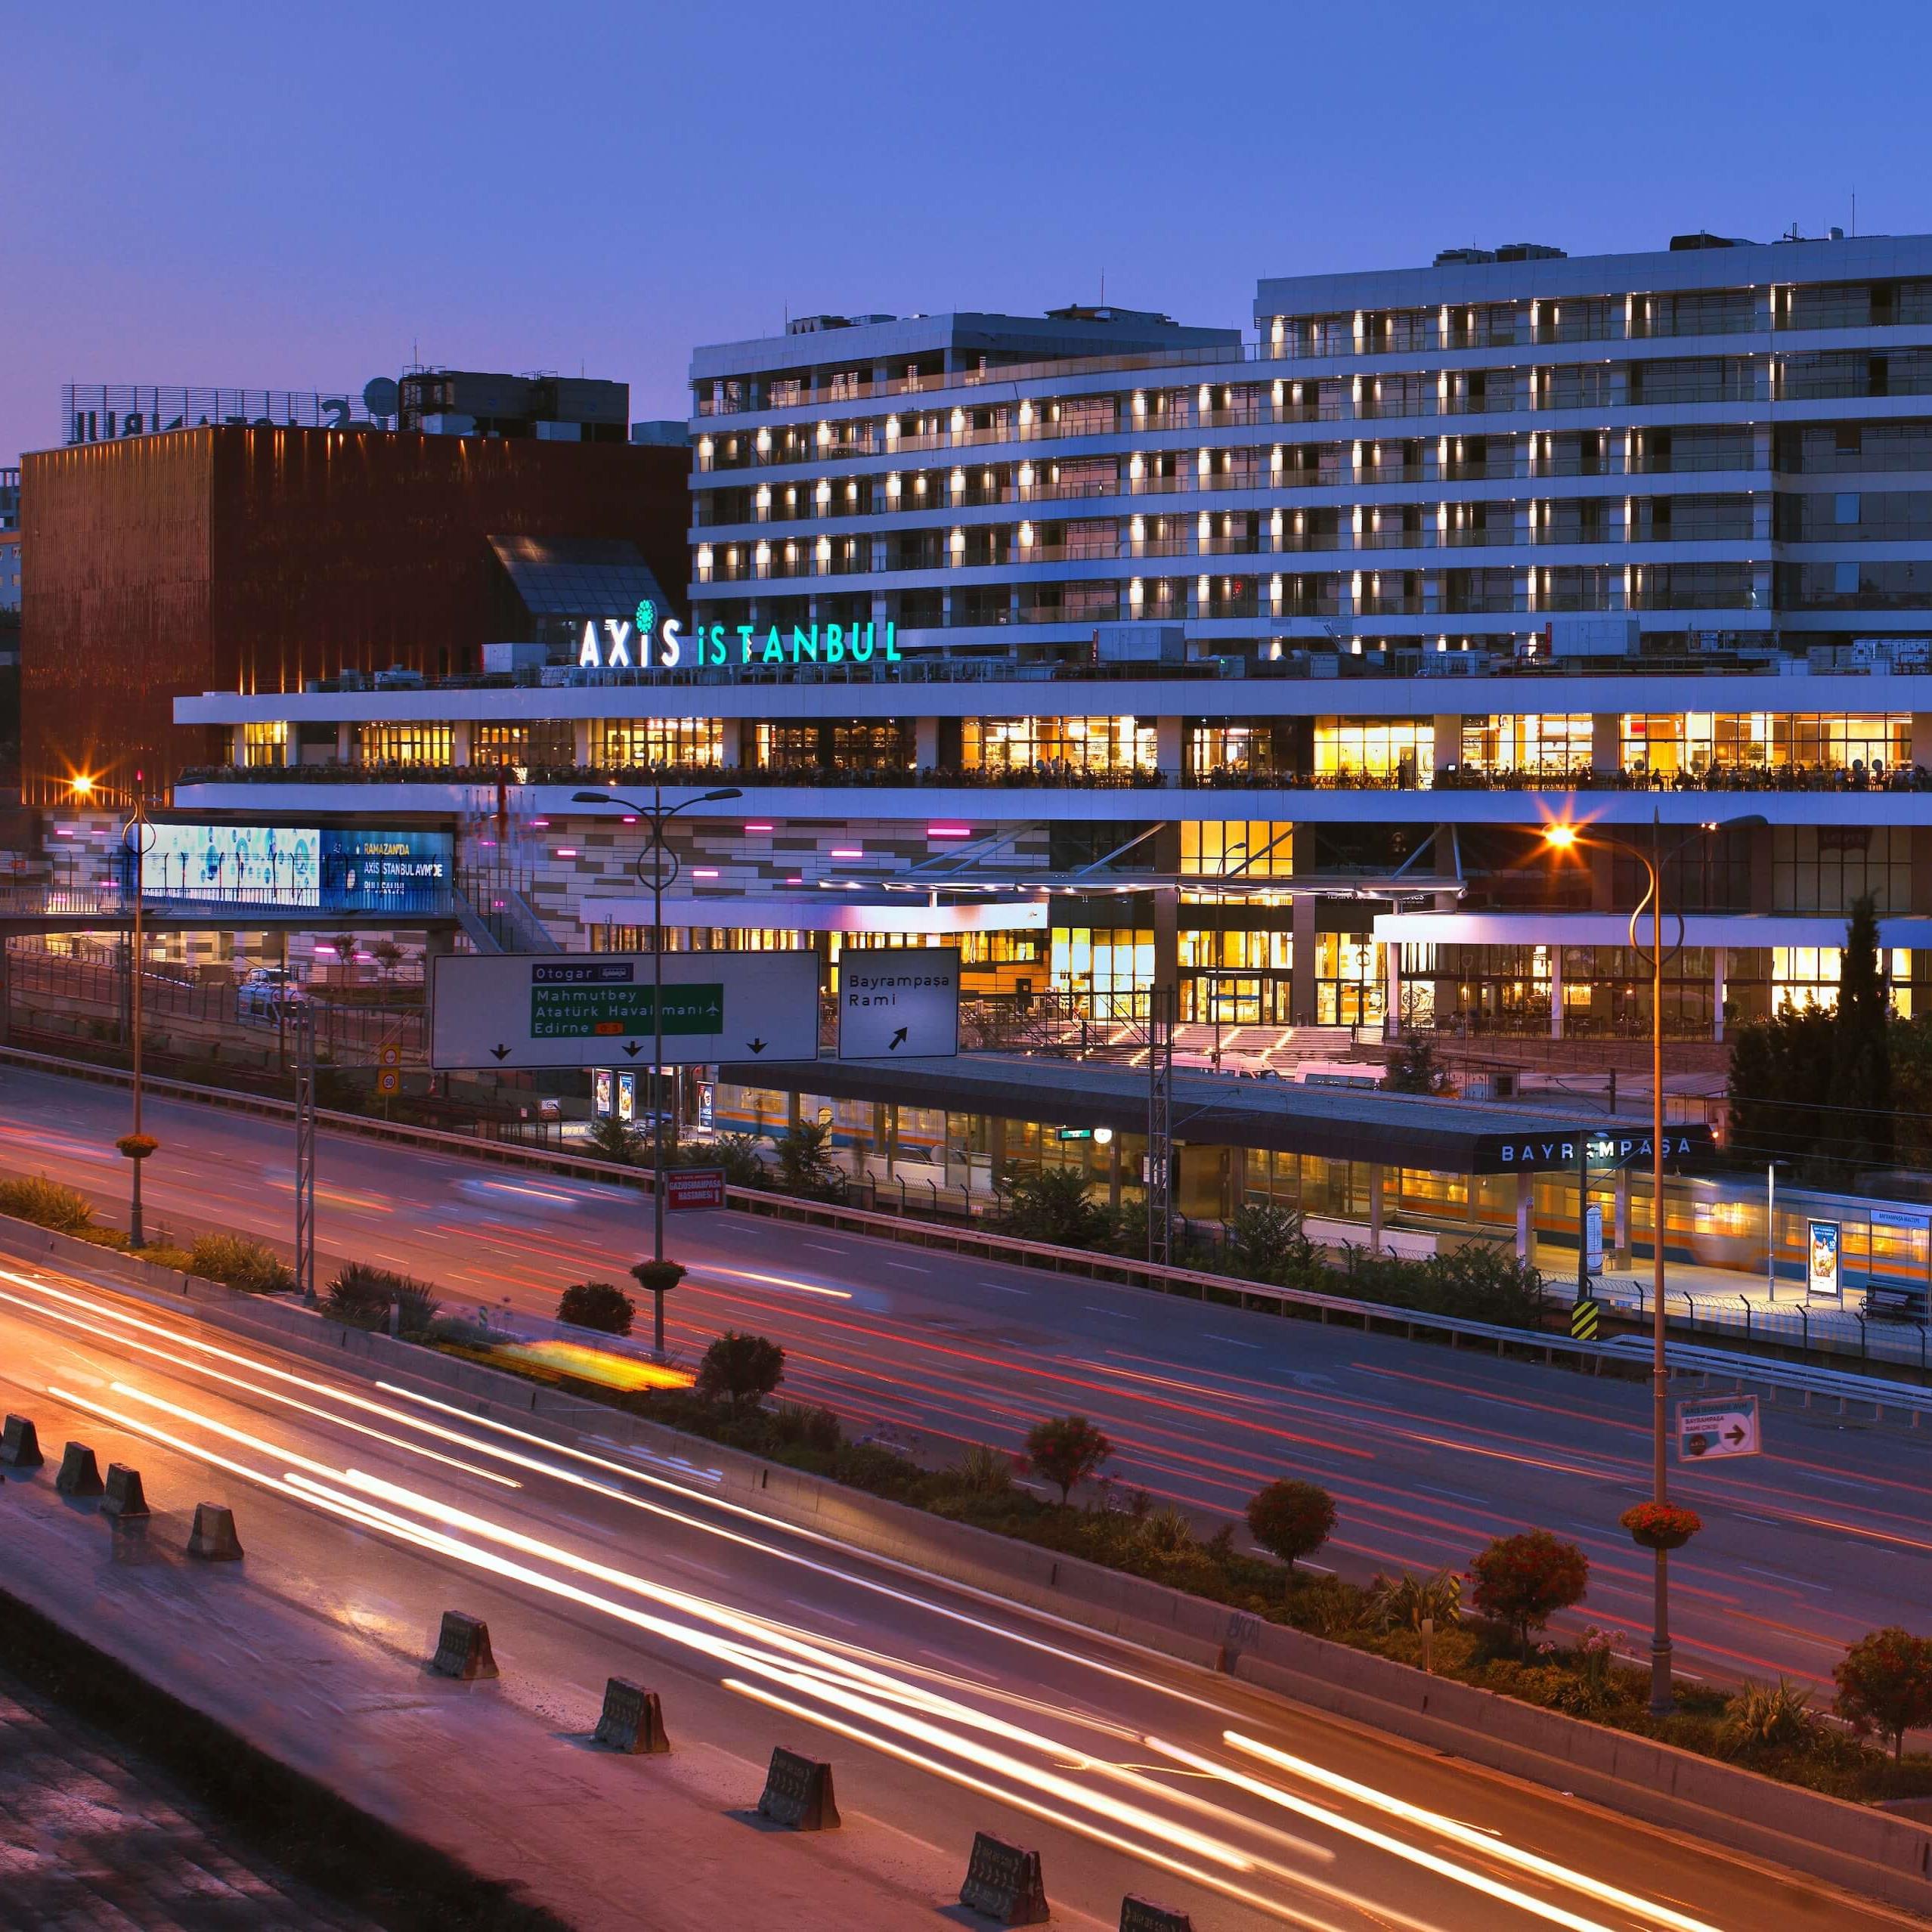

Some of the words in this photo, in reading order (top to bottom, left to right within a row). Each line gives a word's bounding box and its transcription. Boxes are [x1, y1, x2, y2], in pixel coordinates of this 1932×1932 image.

[536, 968, 593, 981] Otogar
[850, 975, 949, 990] Bayrampaşa
[537, 990, 636, 1003] Mahmutbey
[850, 994, 896, 1006] Rami
[535, 1006, 599, 1018] Atatürk
[608, 1005, 702, 1017] Havalmanı
[534, 1022, 589, 1034] Edirne
